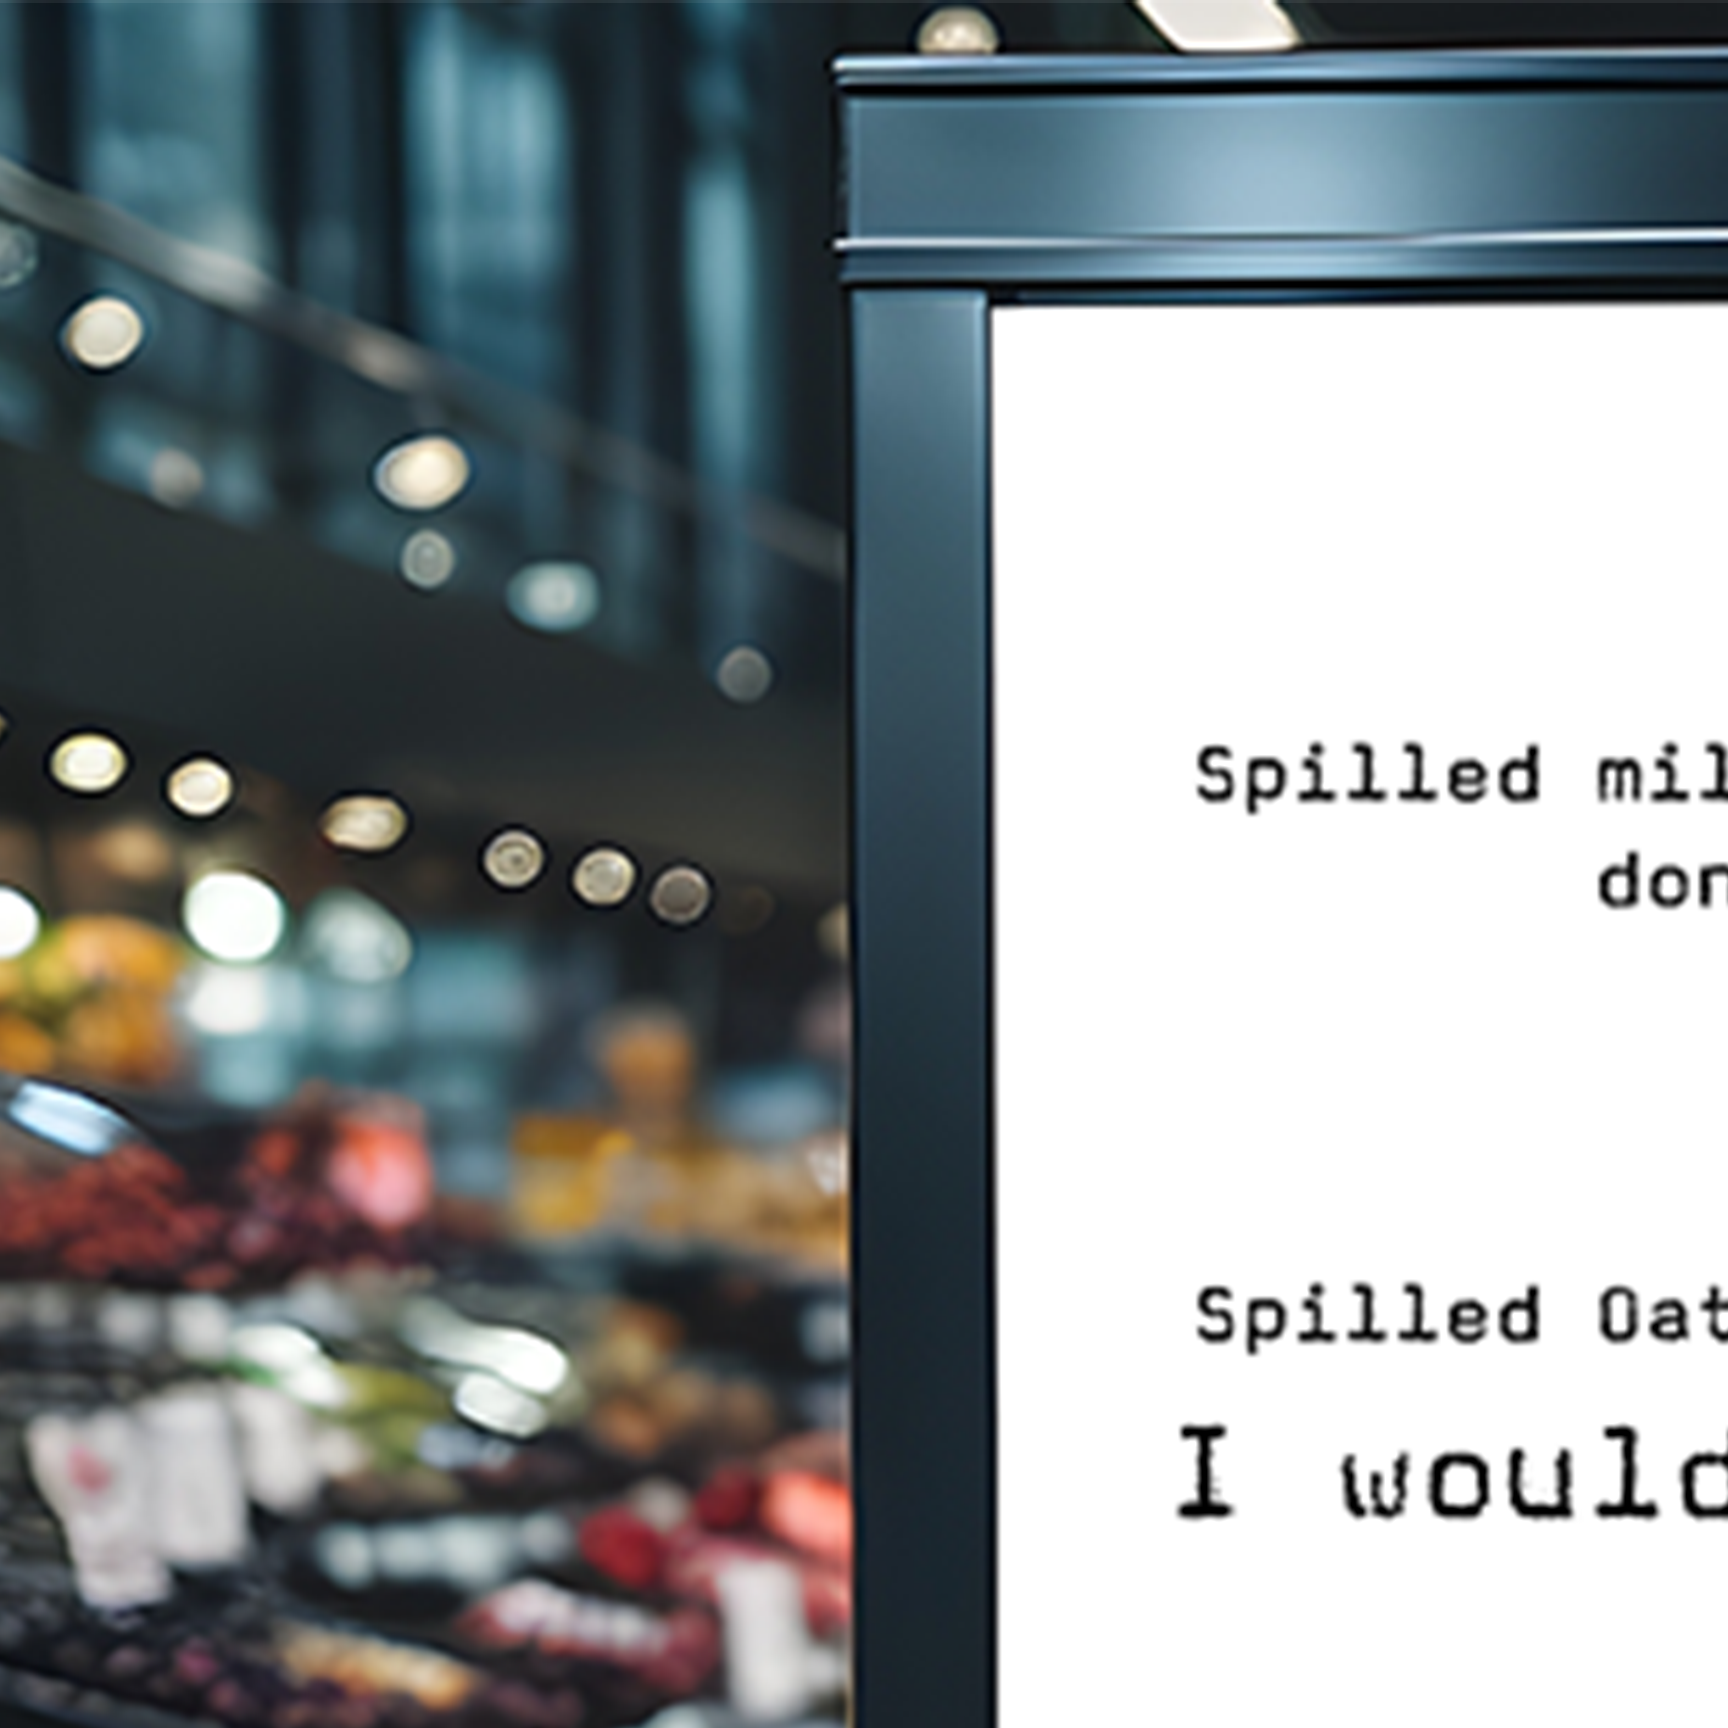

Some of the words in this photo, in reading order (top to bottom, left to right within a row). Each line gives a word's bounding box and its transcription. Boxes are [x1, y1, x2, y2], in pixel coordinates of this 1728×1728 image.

[1196, 741, 1541, 816] Spilled
[1196, 1281, 1541, 1357] Spilled
[1176, 1423, 1234, 1521] I
